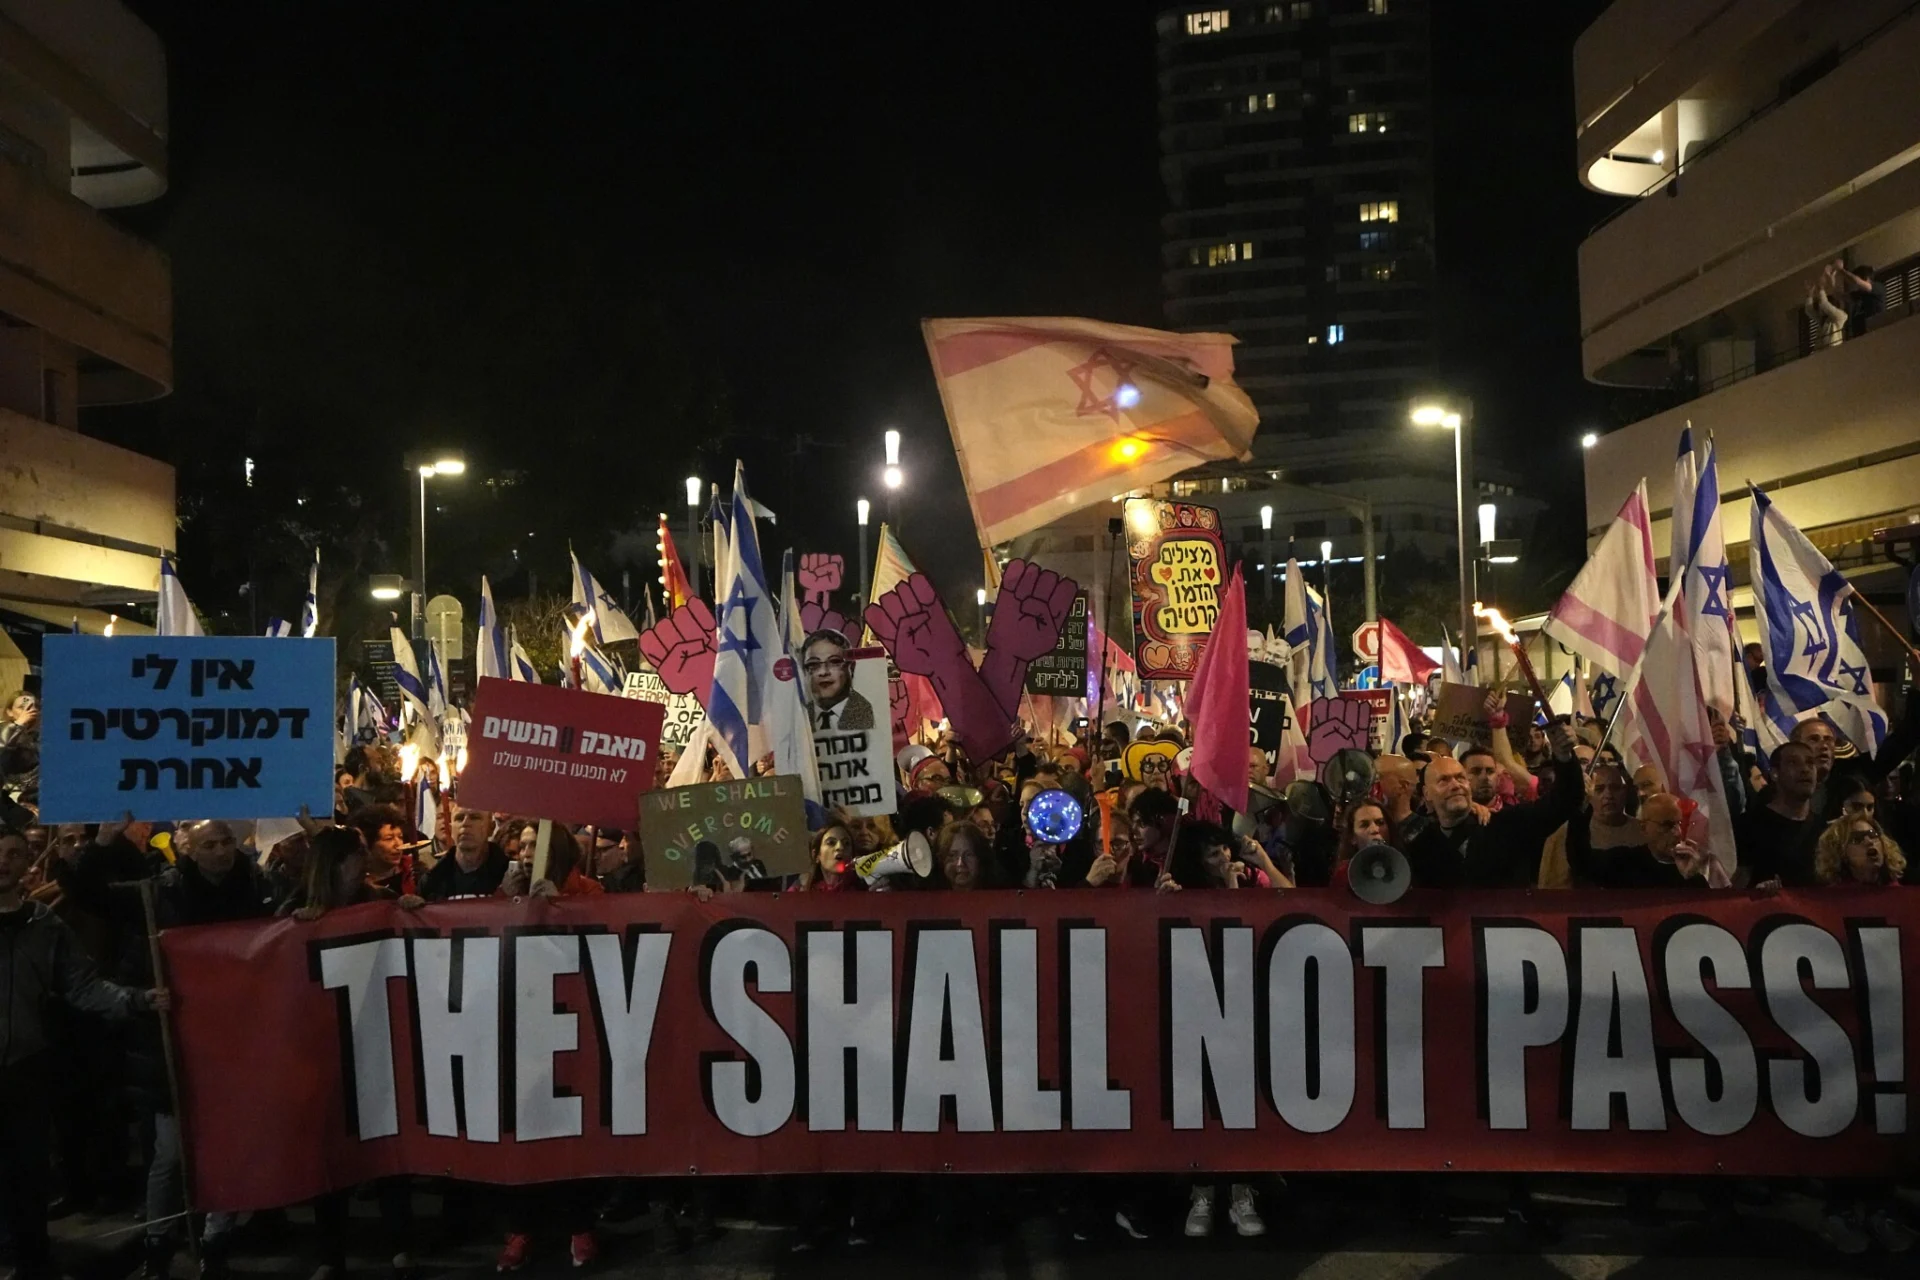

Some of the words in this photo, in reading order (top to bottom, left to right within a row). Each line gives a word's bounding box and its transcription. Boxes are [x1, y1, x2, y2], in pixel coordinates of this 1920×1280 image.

[1160, 543, 1212, 566] מצילים
[1178, 567, 1202, 582] את
[1163, 605, 1218, 632] קרטיה
[131, 653, 178, 690] לי
[190, 658, 255, 697] אין
[629, 674, 665, 691] LEVIN
[674, 695, 688, 708] IS
[70, 707, 310, 747] דמוקרטיה
[677, 710, 703, 724] OF
[482, 716, 558, 748] הנשים
[814, 731, 868, 757] ממה
[580, 730, 647, 761] מאבק
[493, 751, 522, 768] שלנו
[523, 755, 567, 775] בזכויות
[570, 762, 607, 782] תפגעו
[818, 757, 870, 782] אתה
[118, 757, 262, 791] אחרת
[610, 768, 627, 783] לא
[658, 791, 691, 811] WE
[715, 781, 787, 803] SHALL
[664, 812, 789, 861] OVERCOME
[319, 930, 673, 1142] THEY
[708, 926, 1132, 1138] SHALL
[1169, 922, 1446, 1134] NOT
[1483, 922, 1907, 1139] PASS!
